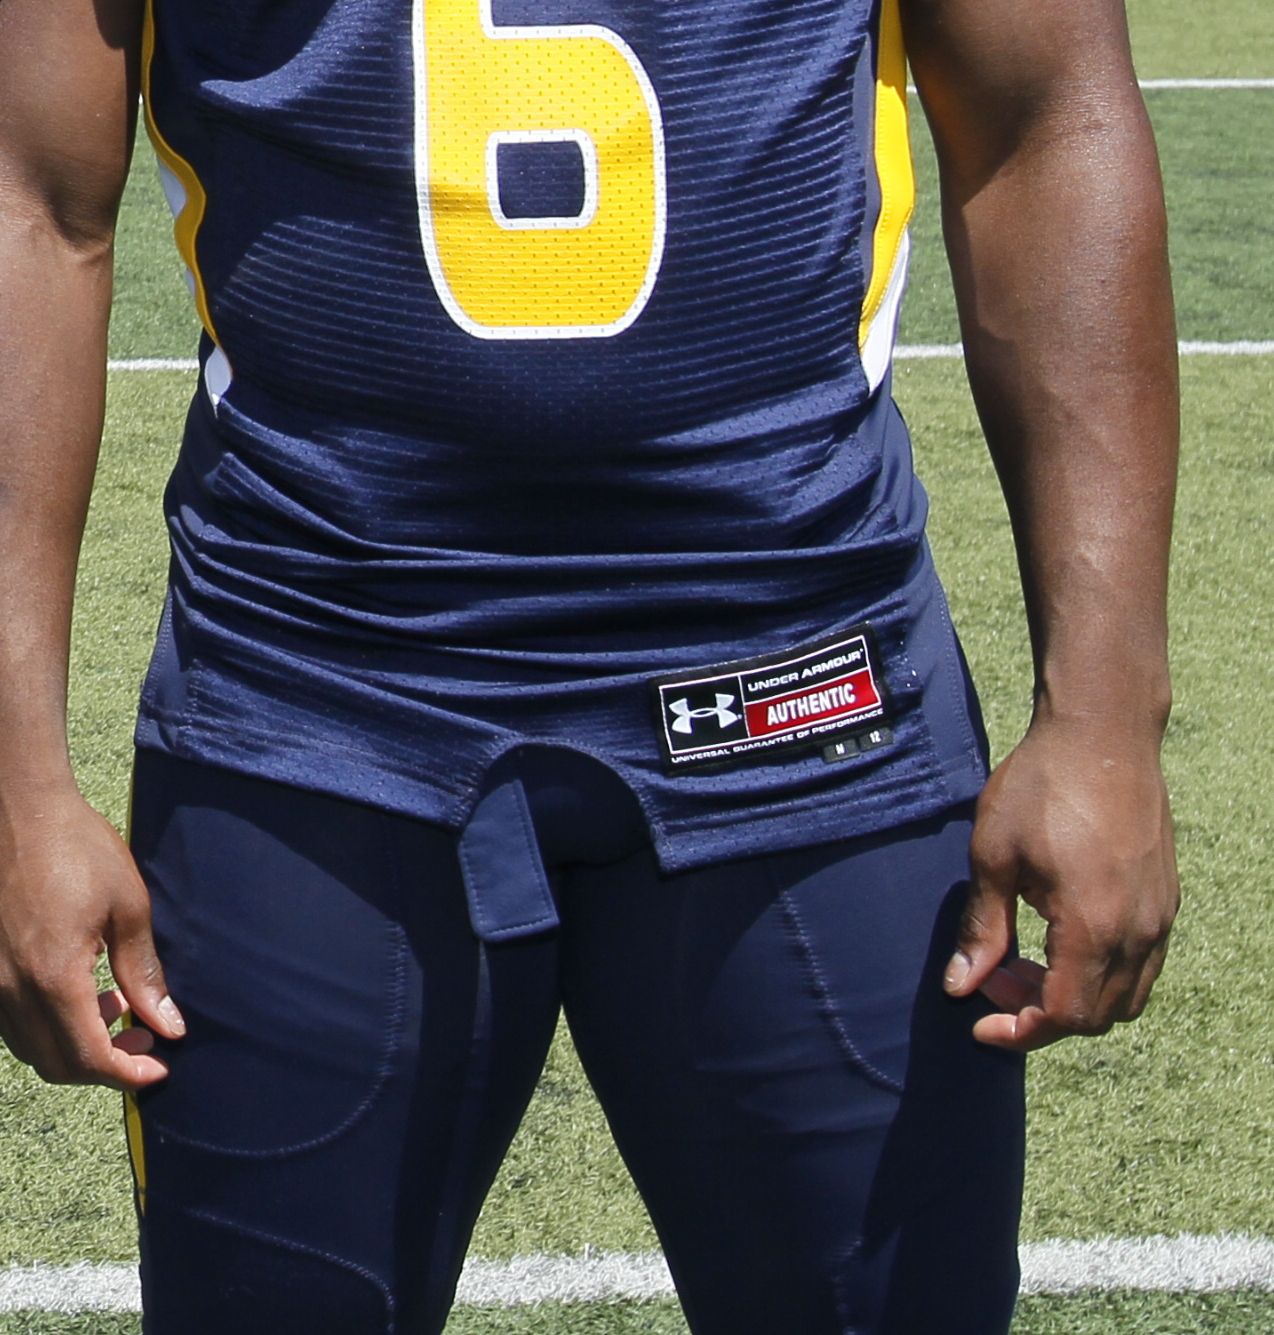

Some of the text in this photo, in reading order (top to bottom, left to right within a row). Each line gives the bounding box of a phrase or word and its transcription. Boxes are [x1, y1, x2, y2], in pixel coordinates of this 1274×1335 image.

[747, 650, 861, 692] UNDER ARMOUR
[767, 683, 856, 726] AUTHENTIC
[671, 708, 884, 764] UNIVERSAL GUARANTEE OF PERFORMANCE
[869, 731, 882, 743] 12
